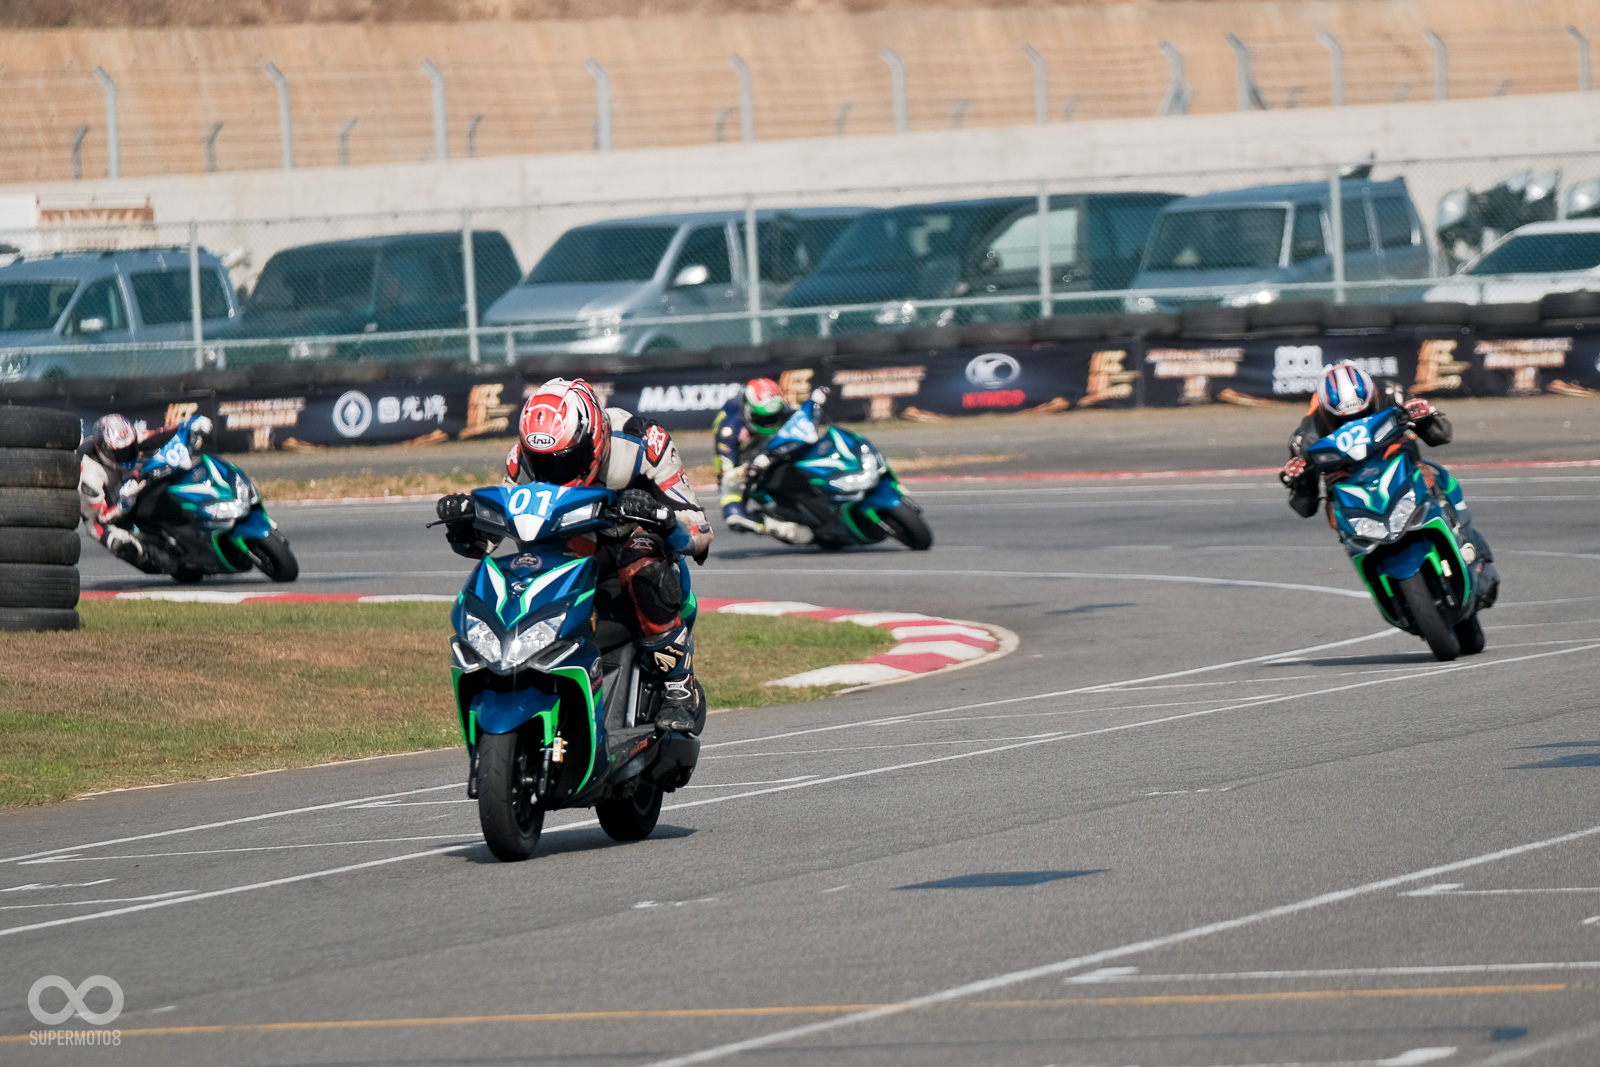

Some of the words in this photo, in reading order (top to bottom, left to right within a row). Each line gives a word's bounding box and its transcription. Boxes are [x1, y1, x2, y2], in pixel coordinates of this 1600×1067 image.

[529, 435, 551, 445] Arai
[1336, 425, 1371, 452] 02
[508, 487, 553, 516] 01
